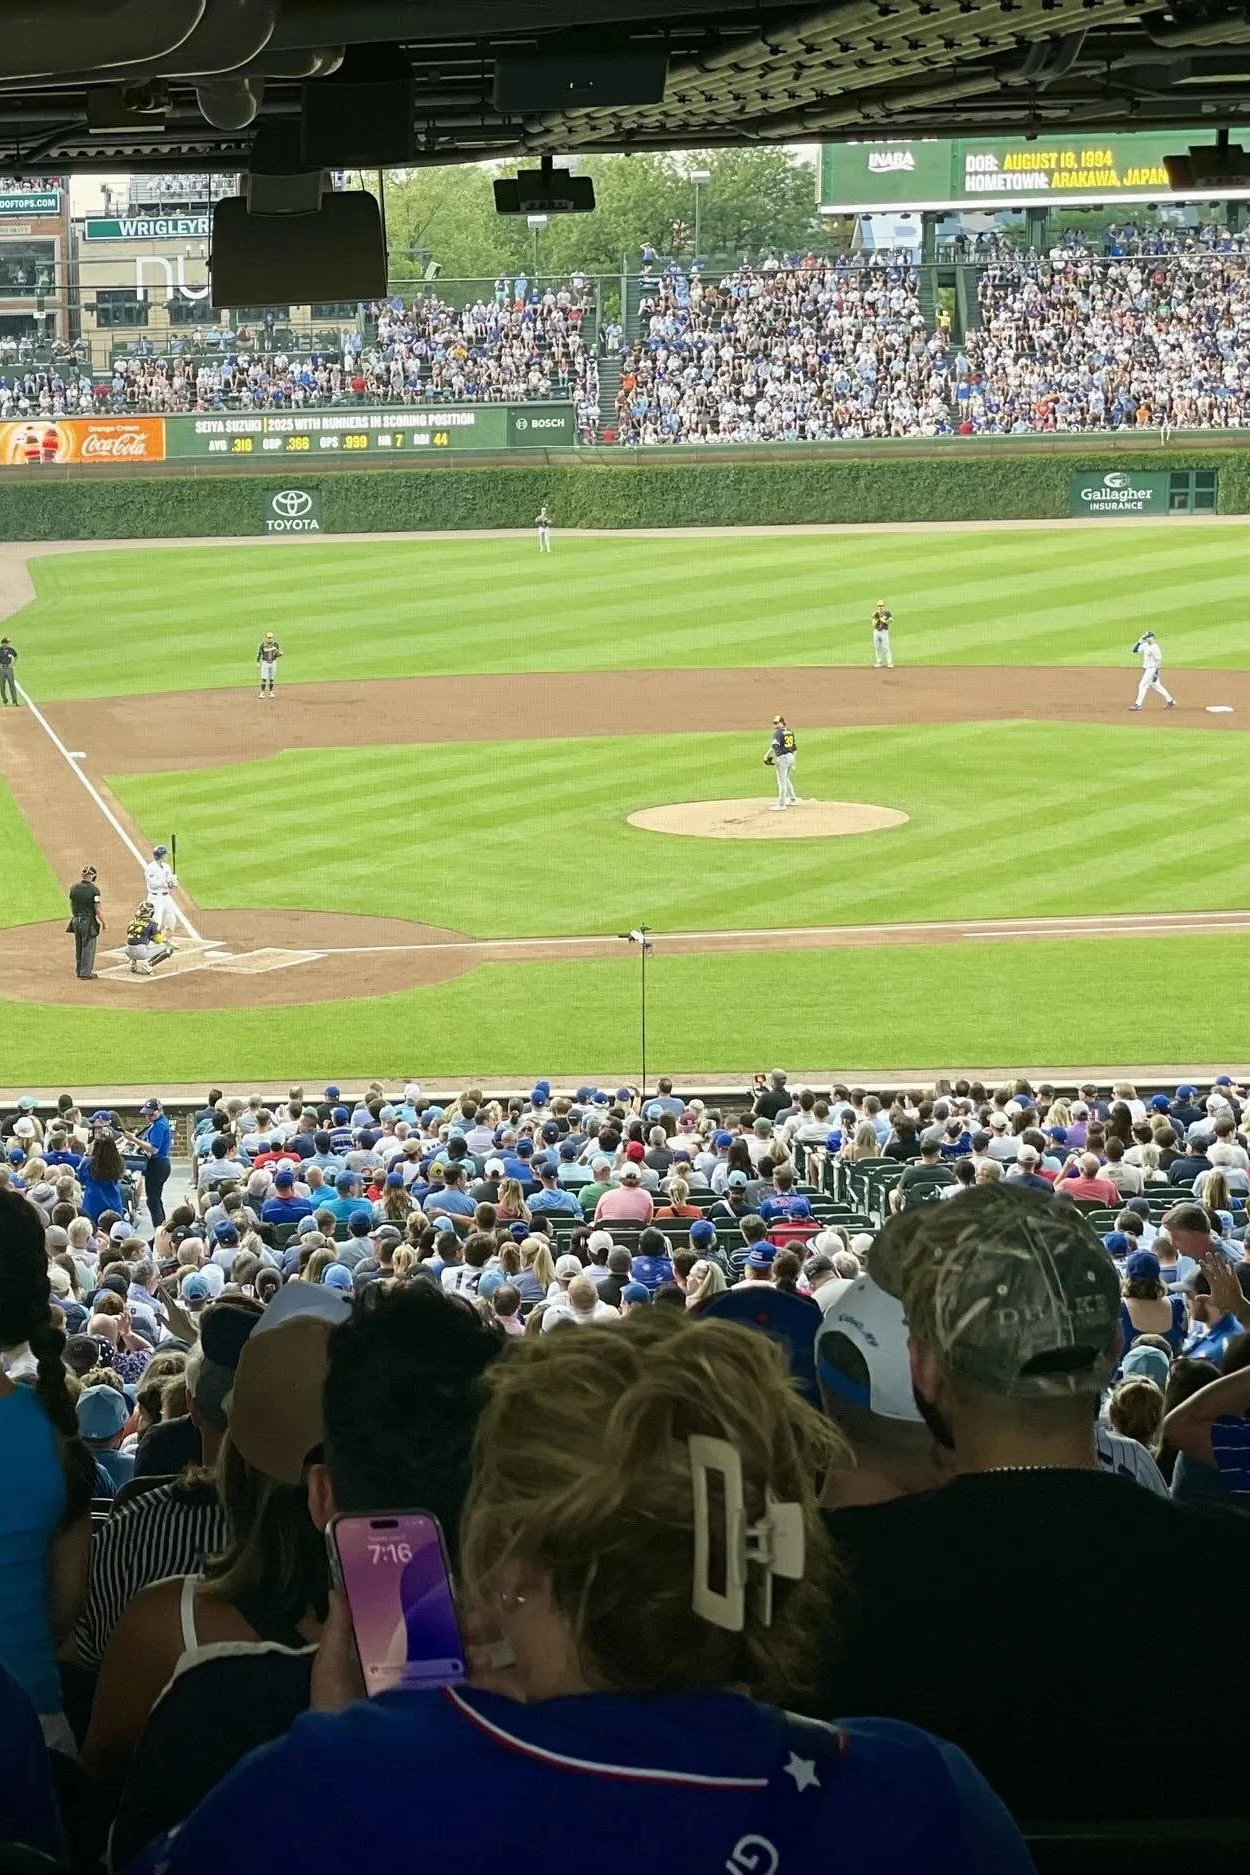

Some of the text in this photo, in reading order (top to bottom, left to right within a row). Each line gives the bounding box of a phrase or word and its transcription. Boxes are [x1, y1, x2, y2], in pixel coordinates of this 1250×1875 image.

[965, 154, 998, 172] DOB:
[1004, 152, 1057, 170] AUGUST
[1081, 150, 1113, 167] 1994
[965, 167, 1169, 191] HOMETOWN: ARAKAWA, JAPAN
[195, 412, 475, 433] SEIYA SUZUKI 2025 WITH RUNNERS IN SCORING POSITION
[531, 418, 565, 428] BOSCH
[208, 439, 227, 451] AVG
[395, 434, 403, 446] 7
[433, 432, 448, 446] 44
[1081, 487, 1153, 501] Gallagher
[1090, 502, 1143, 510] INSURANCE
[266, 520, 319, 530] TOYOTA
[367, 1543, 413, 1565] 7:16
